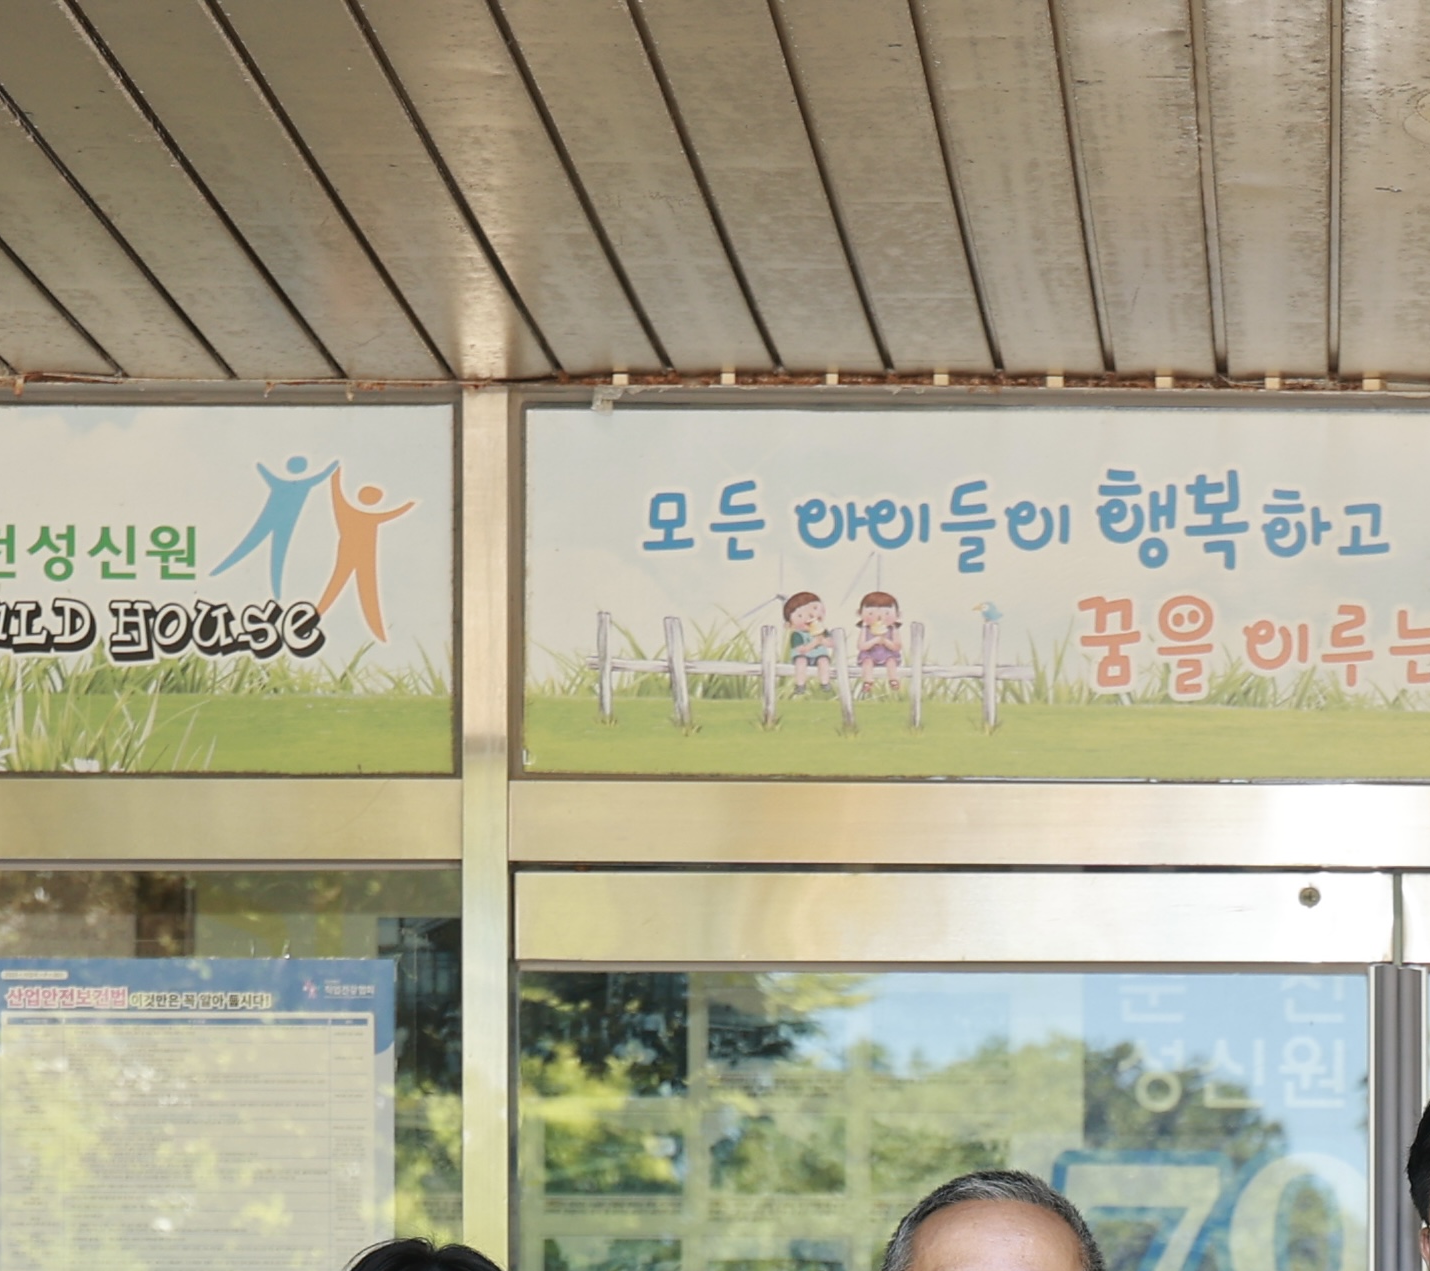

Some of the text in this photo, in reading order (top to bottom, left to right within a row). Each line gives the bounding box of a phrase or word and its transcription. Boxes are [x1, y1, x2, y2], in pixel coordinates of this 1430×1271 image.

[641, 478, 765, 563] 모든
[794, 478, 1070, 573] 아이들이
[1098, 467, 1390, 571] 행복하고
[1078, 594, 1215, 696] 꿈을
[6, 987, 128, 1009] 산업안전보건법
[130, 992, 179, 1010] 이것만은
